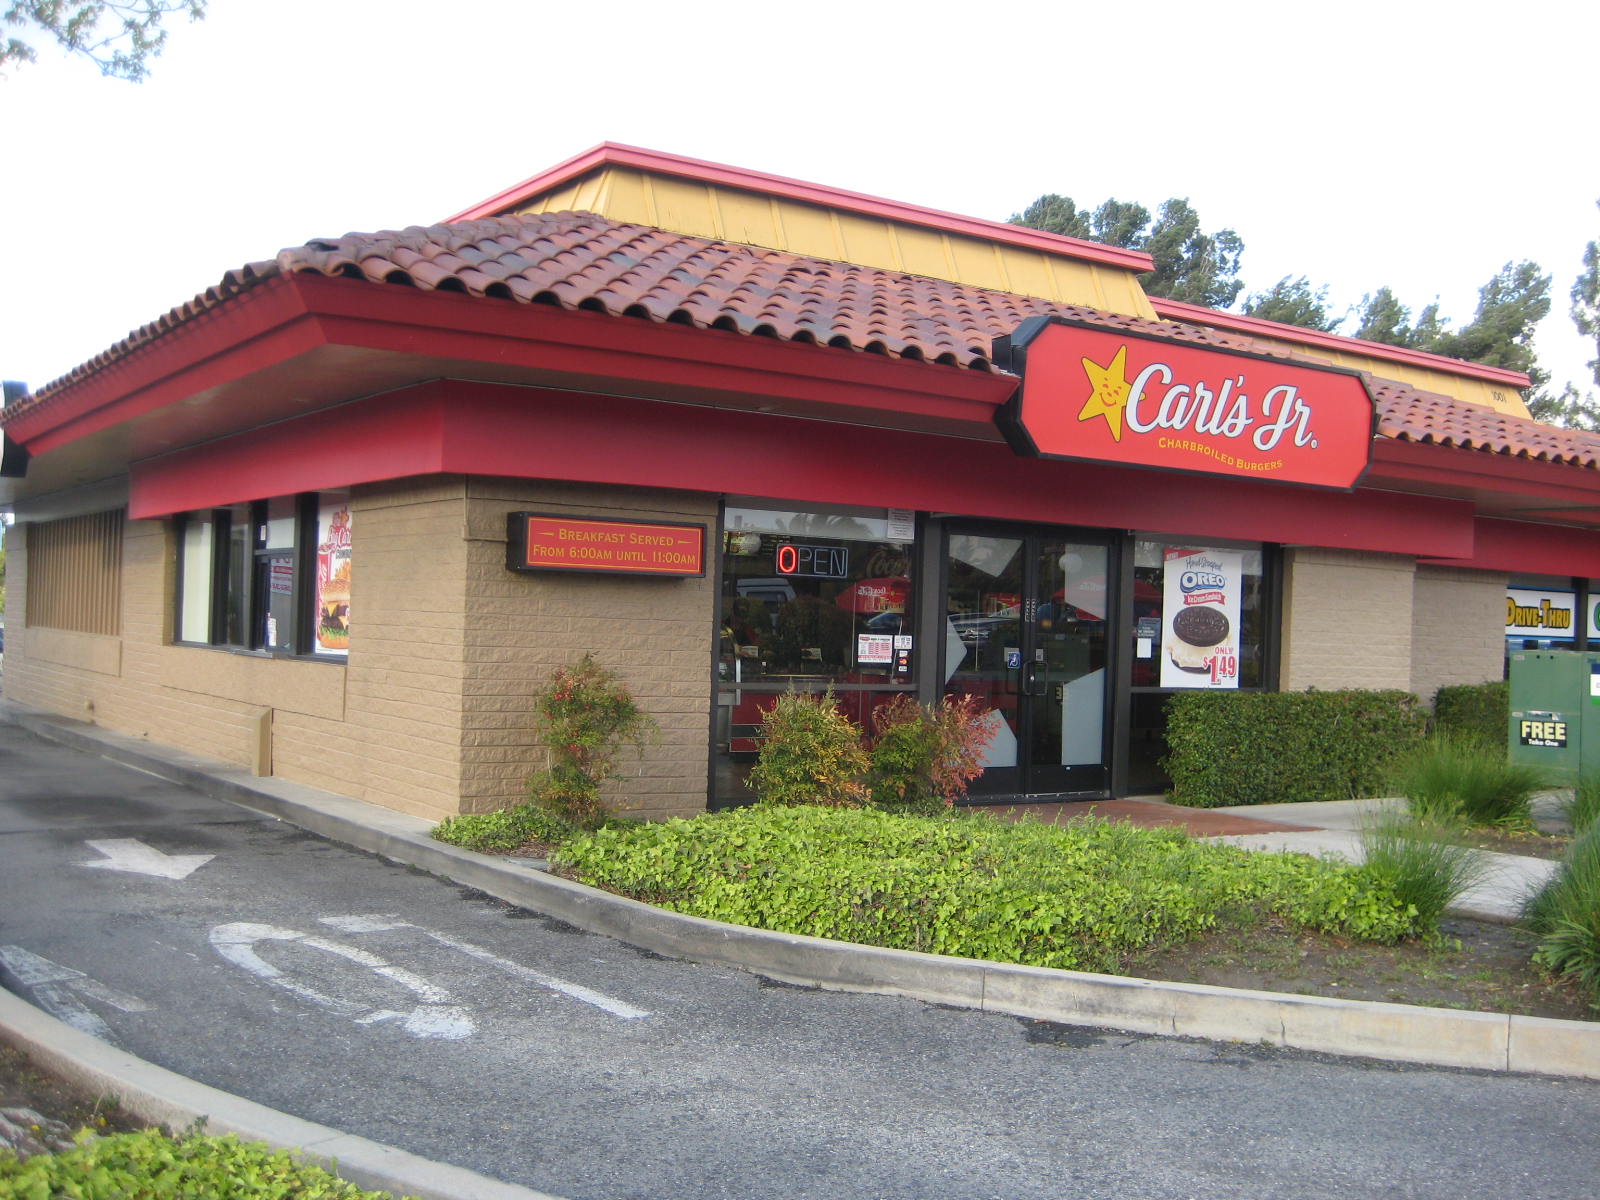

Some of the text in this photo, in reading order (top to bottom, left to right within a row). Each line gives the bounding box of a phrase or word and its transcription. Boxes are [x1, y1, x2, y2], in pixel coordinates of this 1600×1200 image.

[1125, 362, 1318, 451] Carl's Jr.
[1158, 436, 1283, 472] CHARBROILED BURGERS
[559, 528, 674, 546] BREAKFAST SERVED
[533, 544, 696, 565] FROM 6:00AM UNTIL 11:00AM
[779, 545, 846, 576] OPEN
[1181, 572, 1225, 588] OREO
[1505, 597, 1571, 629] DRIVE-THRU
[1215, 647, 1233, 655] ONLY
[1521, 720, 1567, 740] FREE
